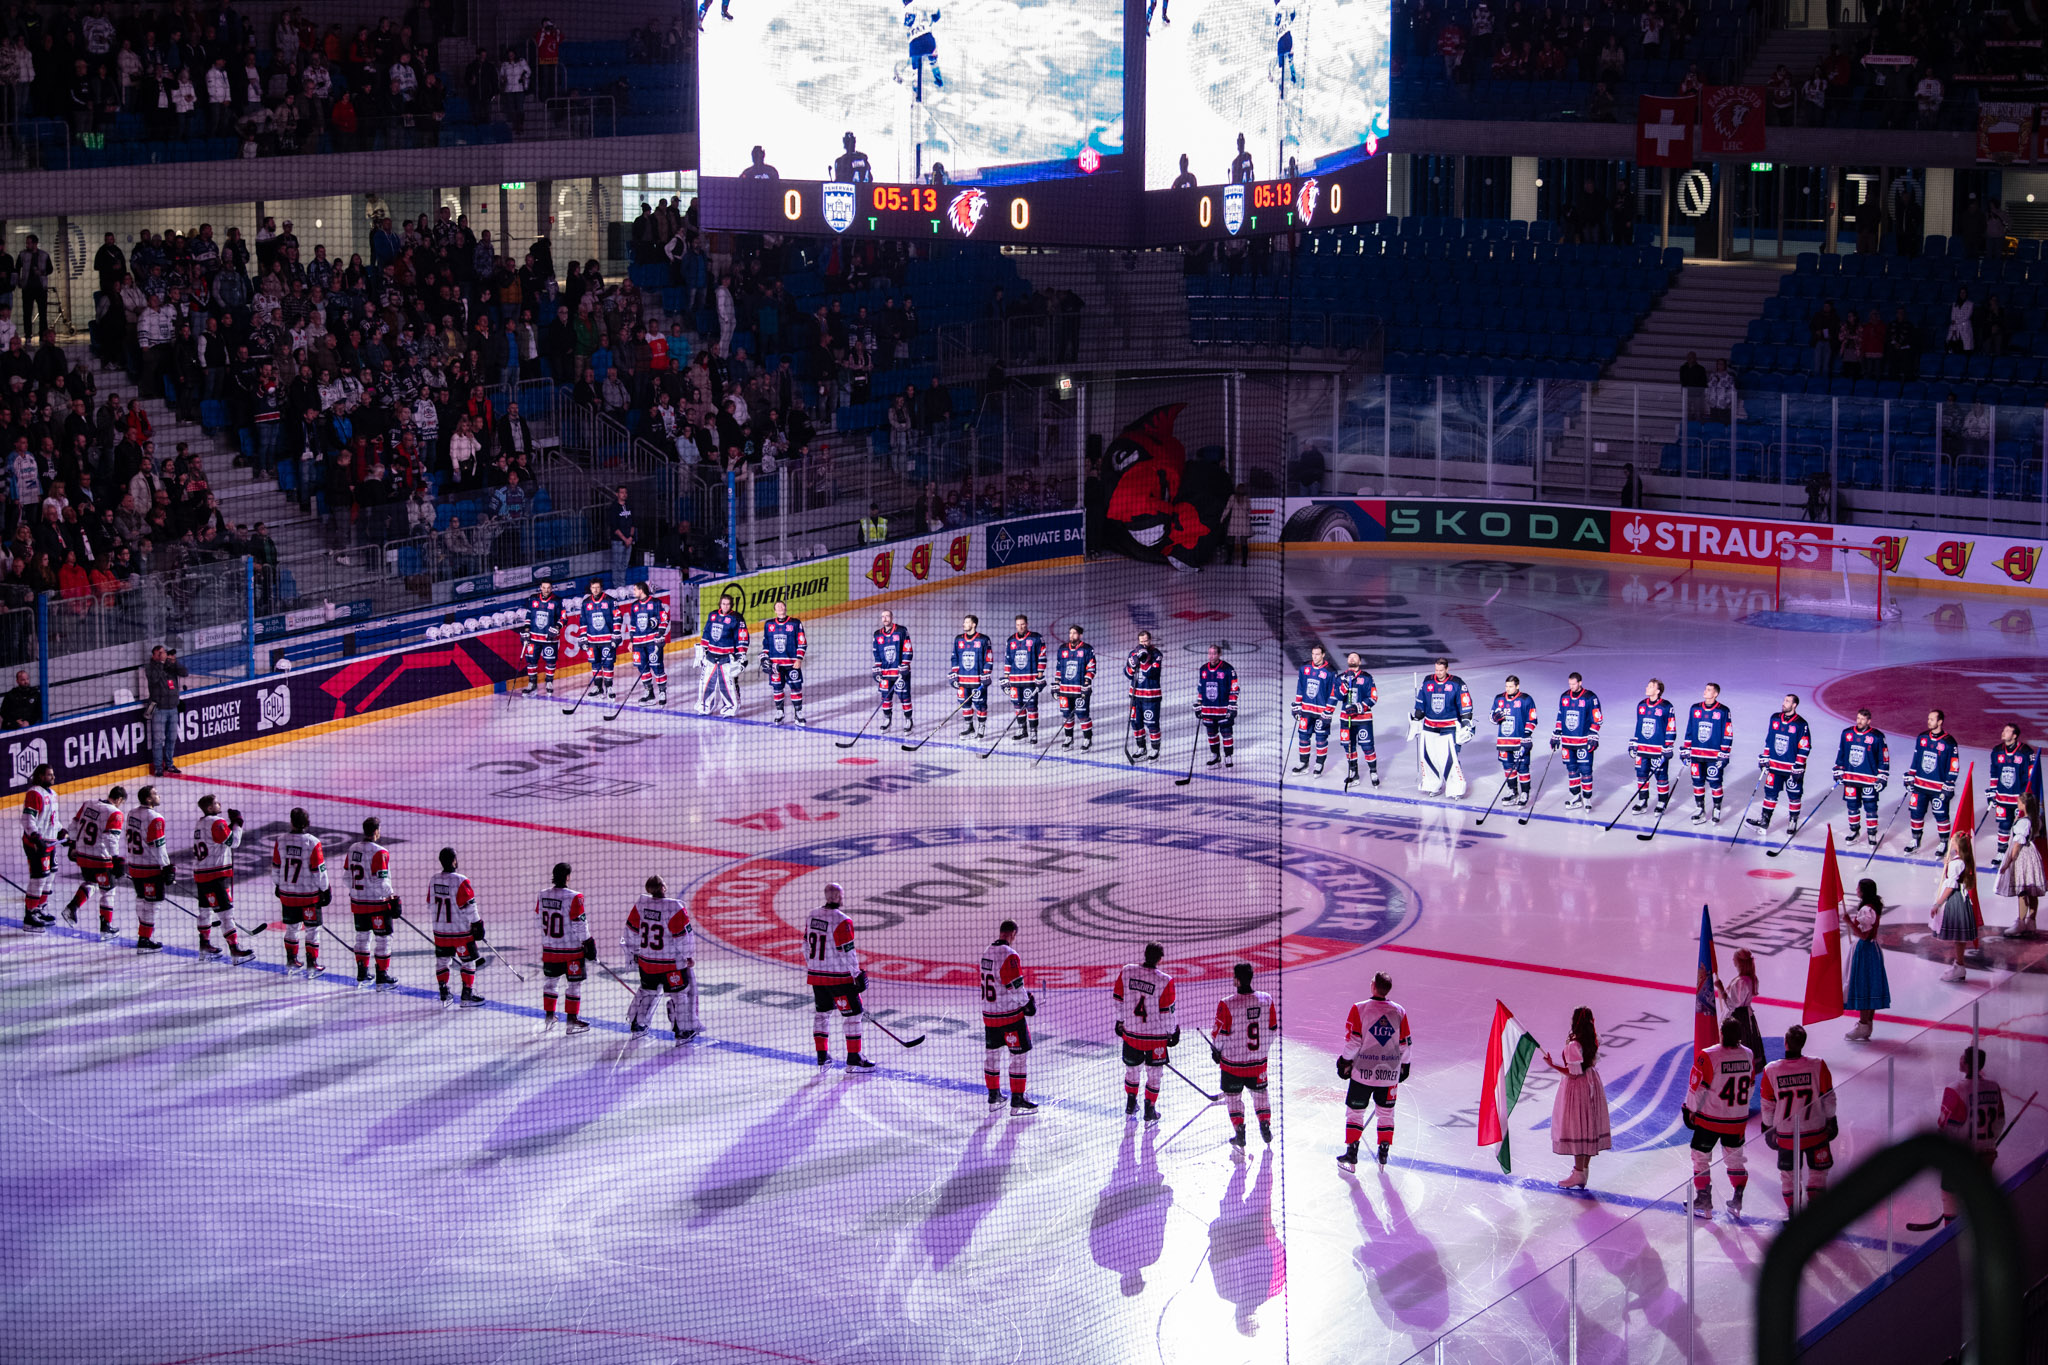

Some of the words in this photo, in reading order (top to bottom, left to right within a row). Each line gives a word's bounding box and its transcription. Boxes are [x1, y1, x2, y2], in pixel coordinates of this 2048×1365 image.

[784, 188, 802, 221] 0
[872, 187, 938, 213] 05:13
[1253, 182, 1293, 209] 05:13
[1329, 183, 1341, 214] 0
[867, 216, 878, 231] T
[930, 218, 941, 233] T
[1010, 197, 1030, 230] 0
[1199, 196, 1211, 228] 0
[1250, 215, 1258, 229] T
[1286, 211, 1293, 226] T
[996, 539, 1012, 552] LGT
[1017, 529, 1061, 549] PRIVATE
[1064, 527, 1084, 542] BA
[1655, 521, 1820, 563] STRAUSS
[202, 700, 241, 721] HOCKEY
[64, 709, 199, 769] CHAMPINS
[202, 718, 241, 738] LEAGUE
[77, 820, 98, 846] 79
[284, 857, 302, 884] 17
[350, 864, 365, 890] 12
[852, 845, 1119, 932] Hydro
[434, 896, 453, 924] 71
[542, 910, 564, 939] 90
[639, 921, 664, 951] 33
[809, 932, 827, 961] 91
[1133, 995, 1148, 1024] 4
[1247, 1021, 1260, 1052] 9
[1373, 1025, 1393, 1037] LGT
[1381, 1052, 1401, 1062] Bankin
[1360, 1068, 1373, 1080] TOP
[1375, 1069, 1399, 1081] SCORER
[1778, 1074, 1811, 1086] SKLENICKA
[1719, 1075, 1751, 1106] 48
[1778, 1088, 1813, 1122] 77
